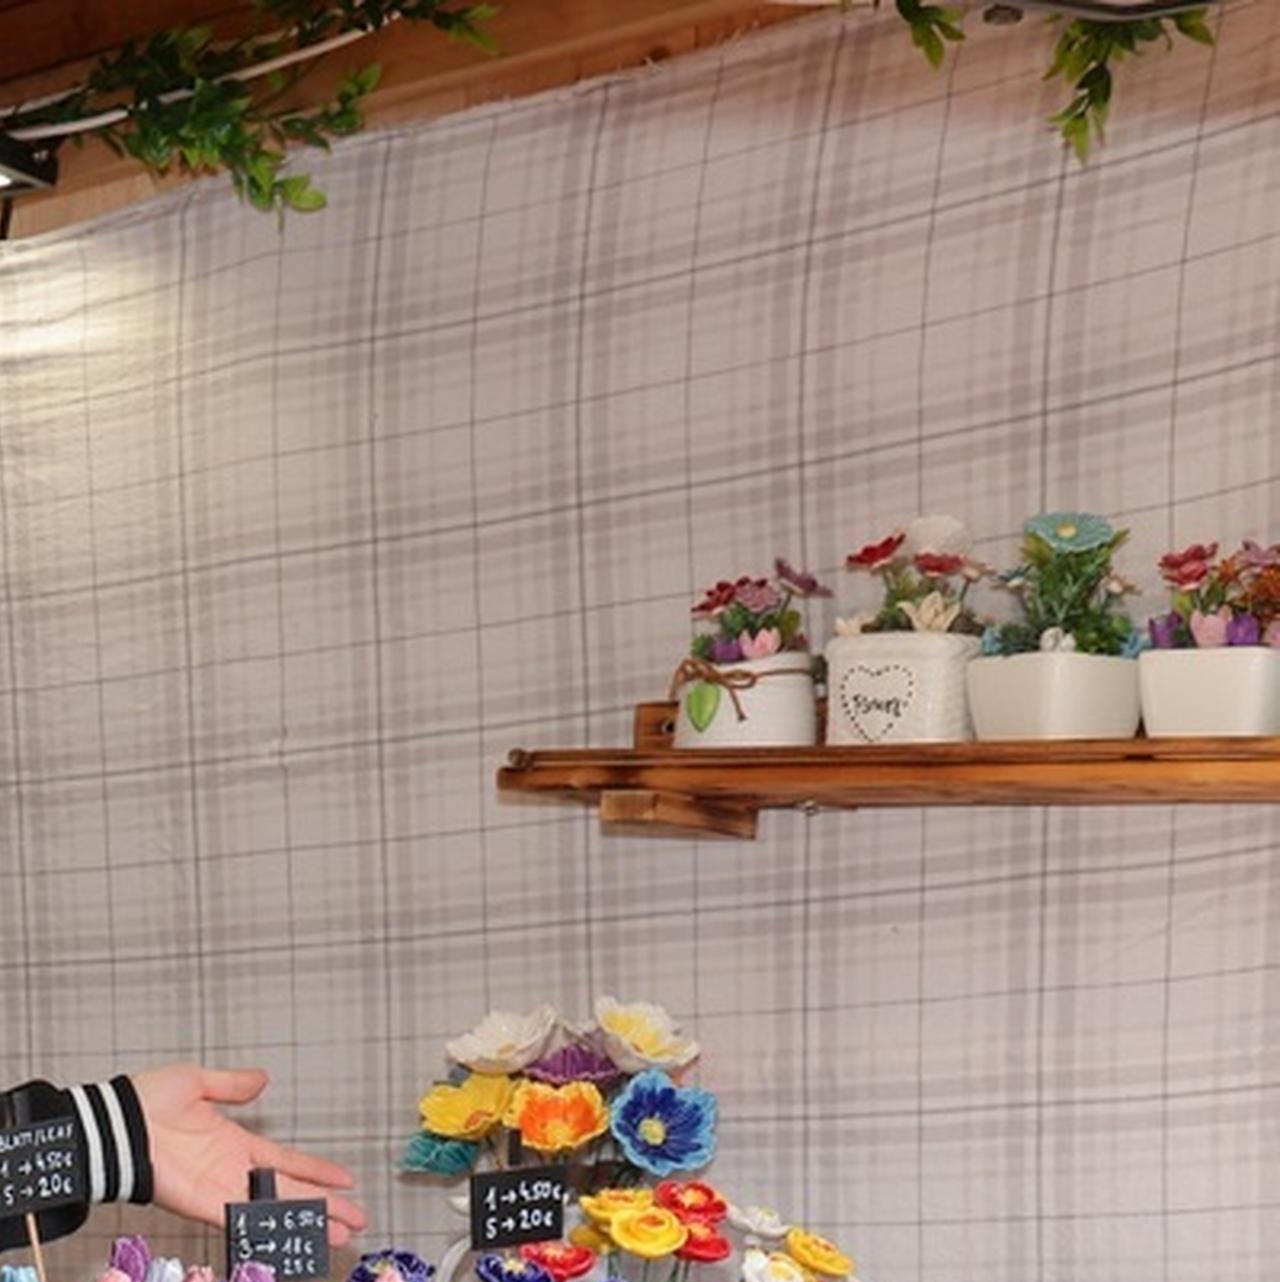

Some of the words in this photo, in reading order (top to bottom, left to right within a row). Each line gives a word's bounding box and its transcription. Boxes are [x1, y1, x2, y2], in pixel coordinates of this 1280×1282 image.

[0, 1163, 10, 1178] 1
[484, 1187, 497, 1211] 1
[485, 1218, 497, 1240] 5
[519, 1209, 553, 1230] 20€
[239, 1237, 252, 1260] 3
